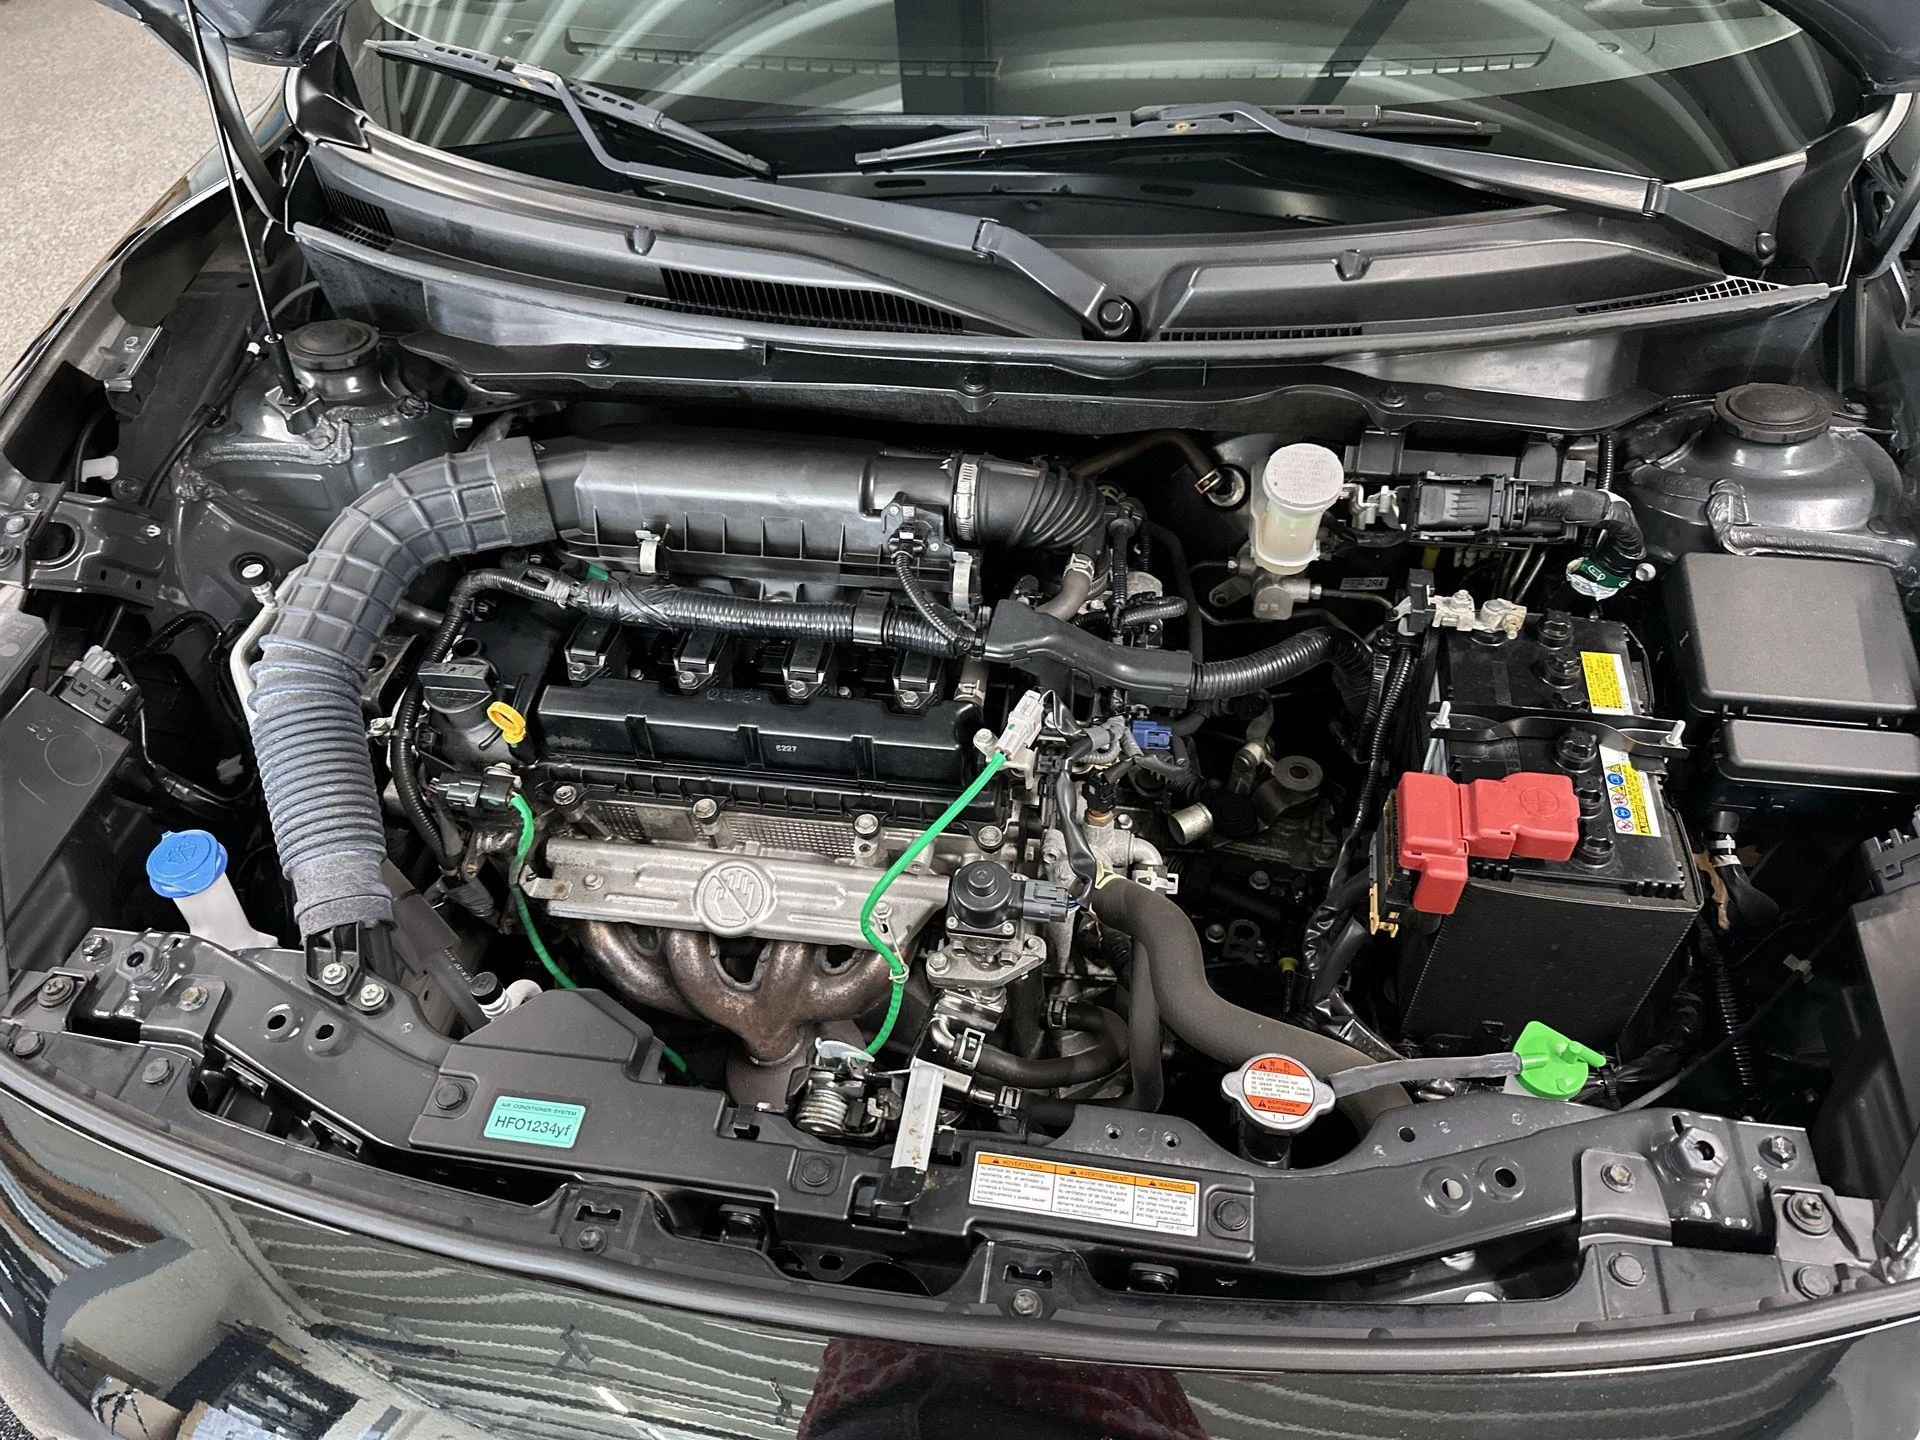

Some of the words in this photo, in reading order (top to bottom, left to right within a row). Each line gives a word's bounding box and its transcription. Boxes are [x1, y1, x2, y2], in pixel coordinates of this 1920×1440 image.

[513, 1104, 552, 1113] CONDITIONER
[495, 1116, 572, 1138] HFO1234yf
[1003, 1161, 1042, 1169] ADVERTENCIA
[1080, 1172, 1127, 1181] AVERTISSEMENT
